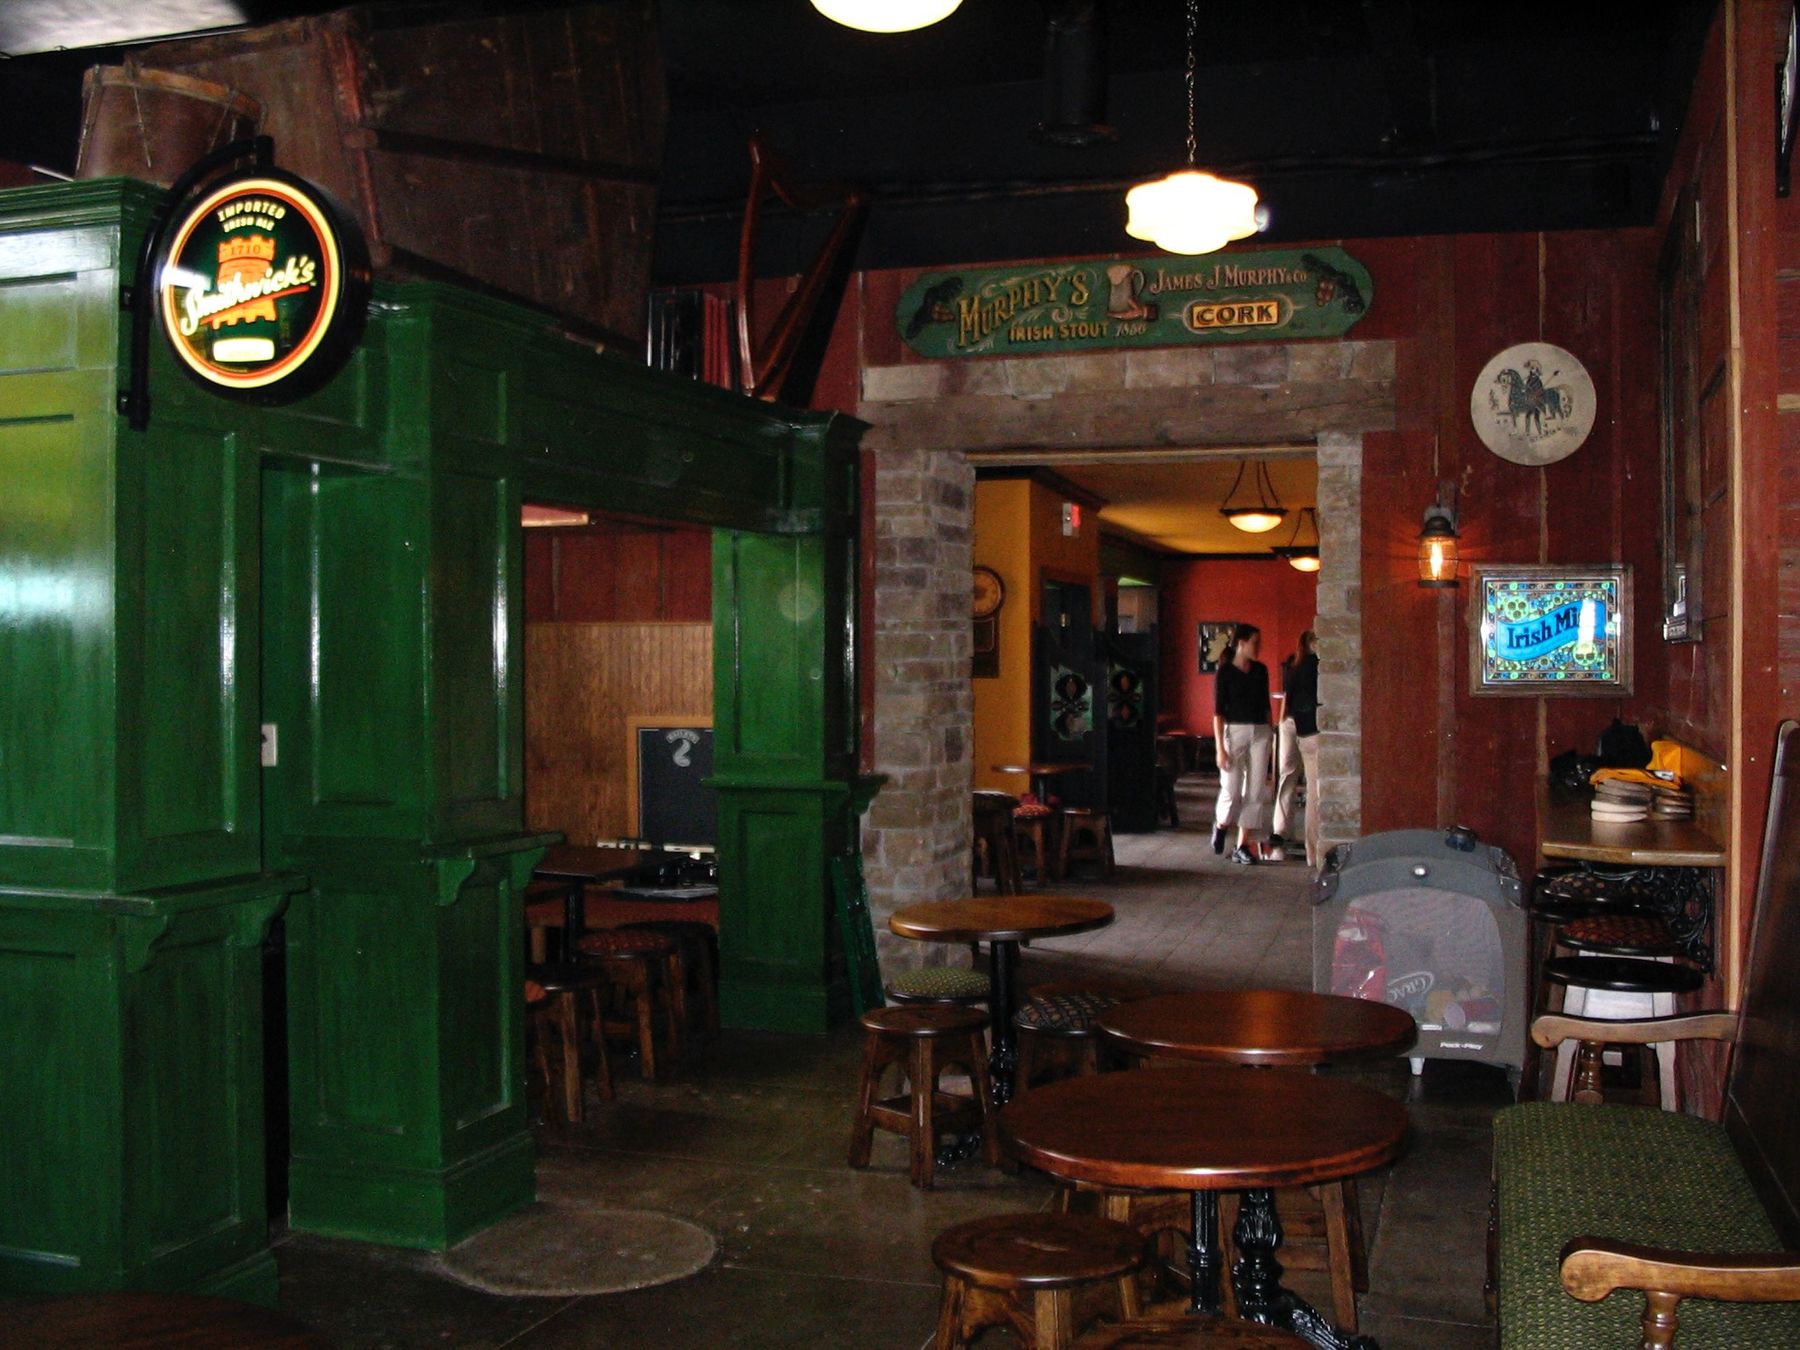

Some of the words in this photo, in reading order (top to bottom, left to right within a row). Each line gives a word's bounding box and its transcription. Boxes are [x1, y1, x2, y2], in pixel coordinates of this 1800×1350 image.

[217, 201, 286, 222] IMPORTED
[230, 245, 261, 255] 1710
[1150, 268, 1202, 294] JAMES
[1206, 264, 1221, 290] J
[180, 255, 316, 336] Smithwick's
[957, 271, 1089, 347] MURPHY'S
[1196, 305, 1274, 326] CORK
[1009, 325, 1054, 342] IRISH
[1059, 320, 1110, 340] STOUT
[1507, 620, 1553, 649] Irish
